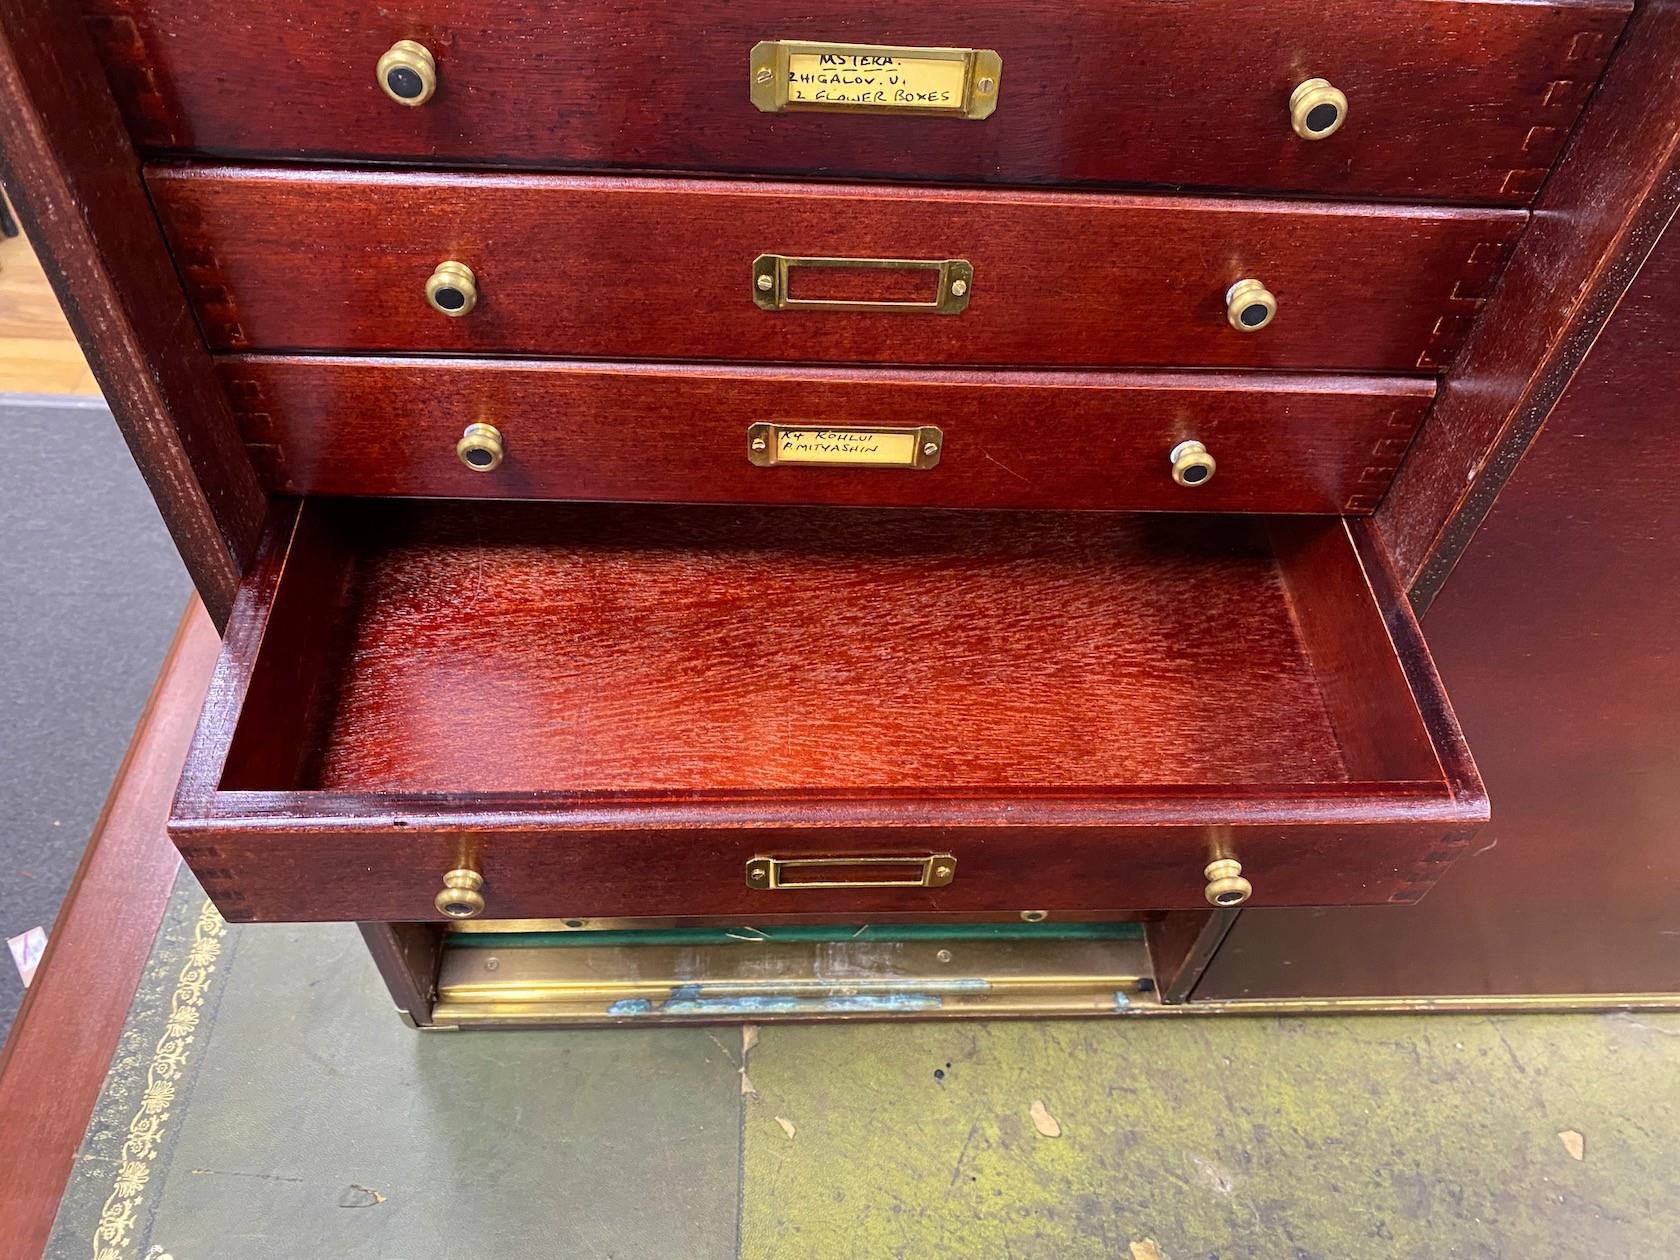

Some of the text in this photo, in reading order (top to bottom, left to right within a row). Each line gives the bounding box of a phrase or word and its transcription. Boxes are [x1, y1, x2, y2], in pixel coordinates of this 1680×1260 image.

[796, 89, 950, 102] 2 FLOWER BOXES
